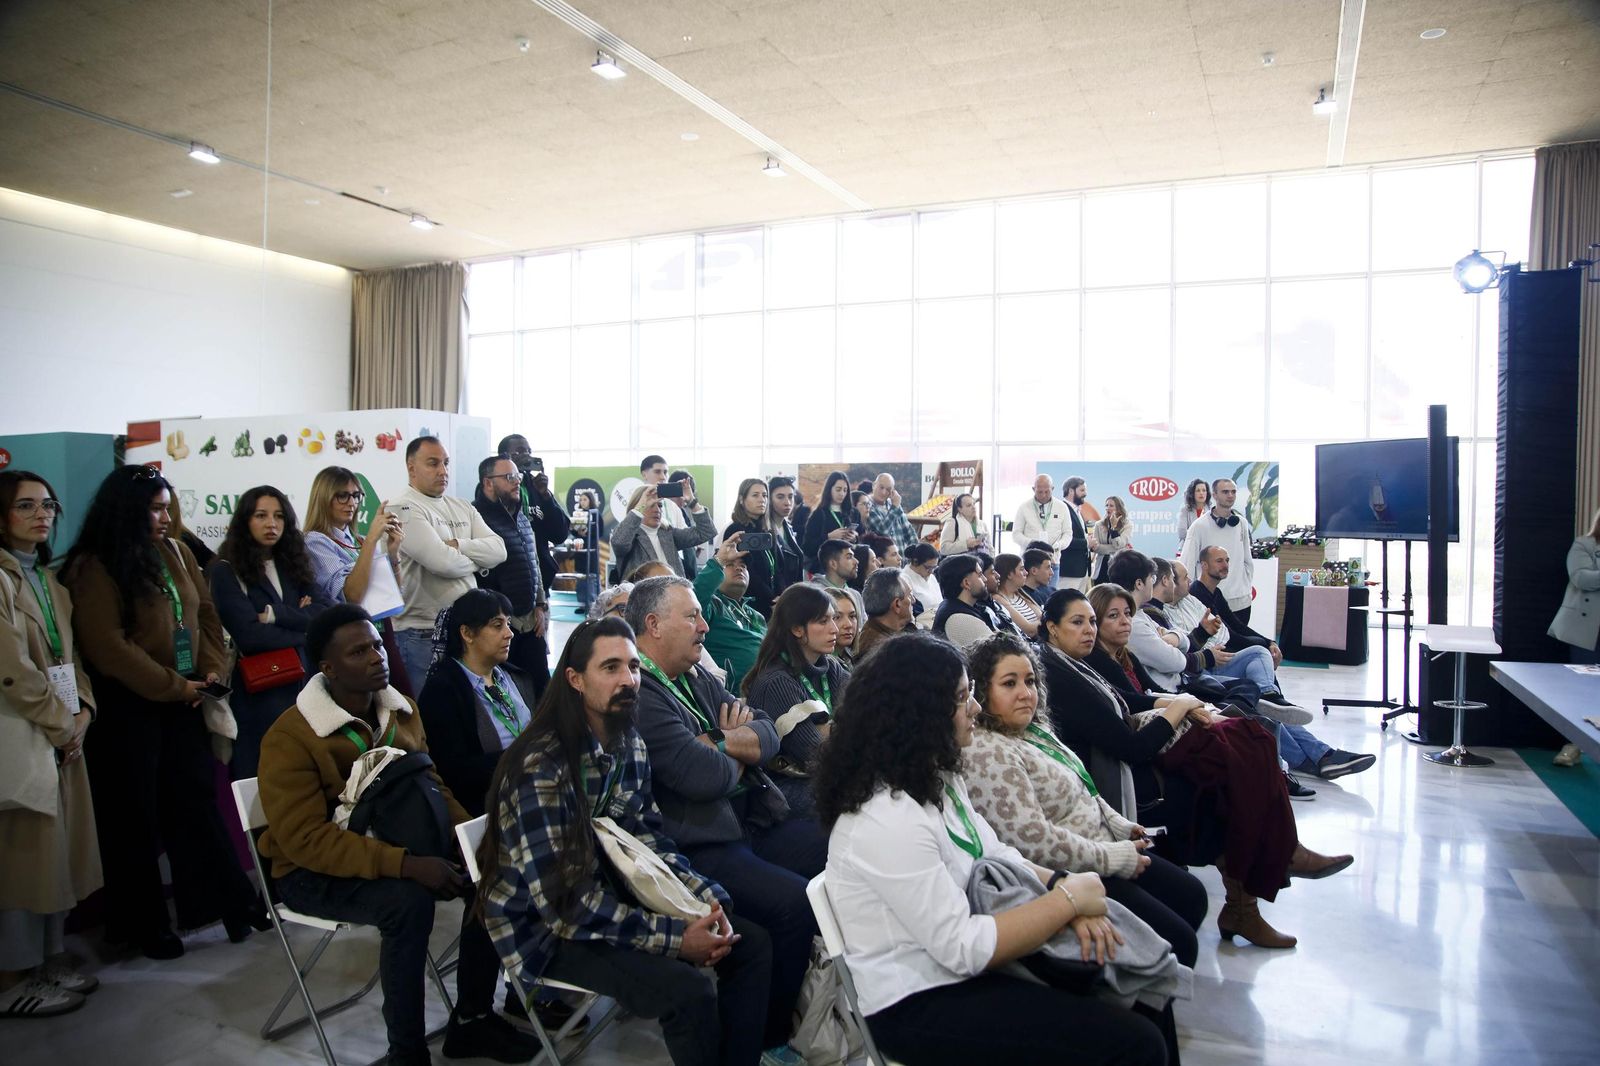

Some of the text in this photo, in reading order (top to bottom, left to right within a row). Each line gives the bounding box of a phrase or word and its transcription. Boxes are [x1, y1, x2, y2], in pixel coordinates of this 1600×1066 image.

[950, 467, 975, 478] BOLLO
[1131, 478, 1176, 497] TROPS
[1128, 510, 1172, 523] empre
[196, 525, 227, 538] PASSI
[1142, 521, 1178, 536] punt
